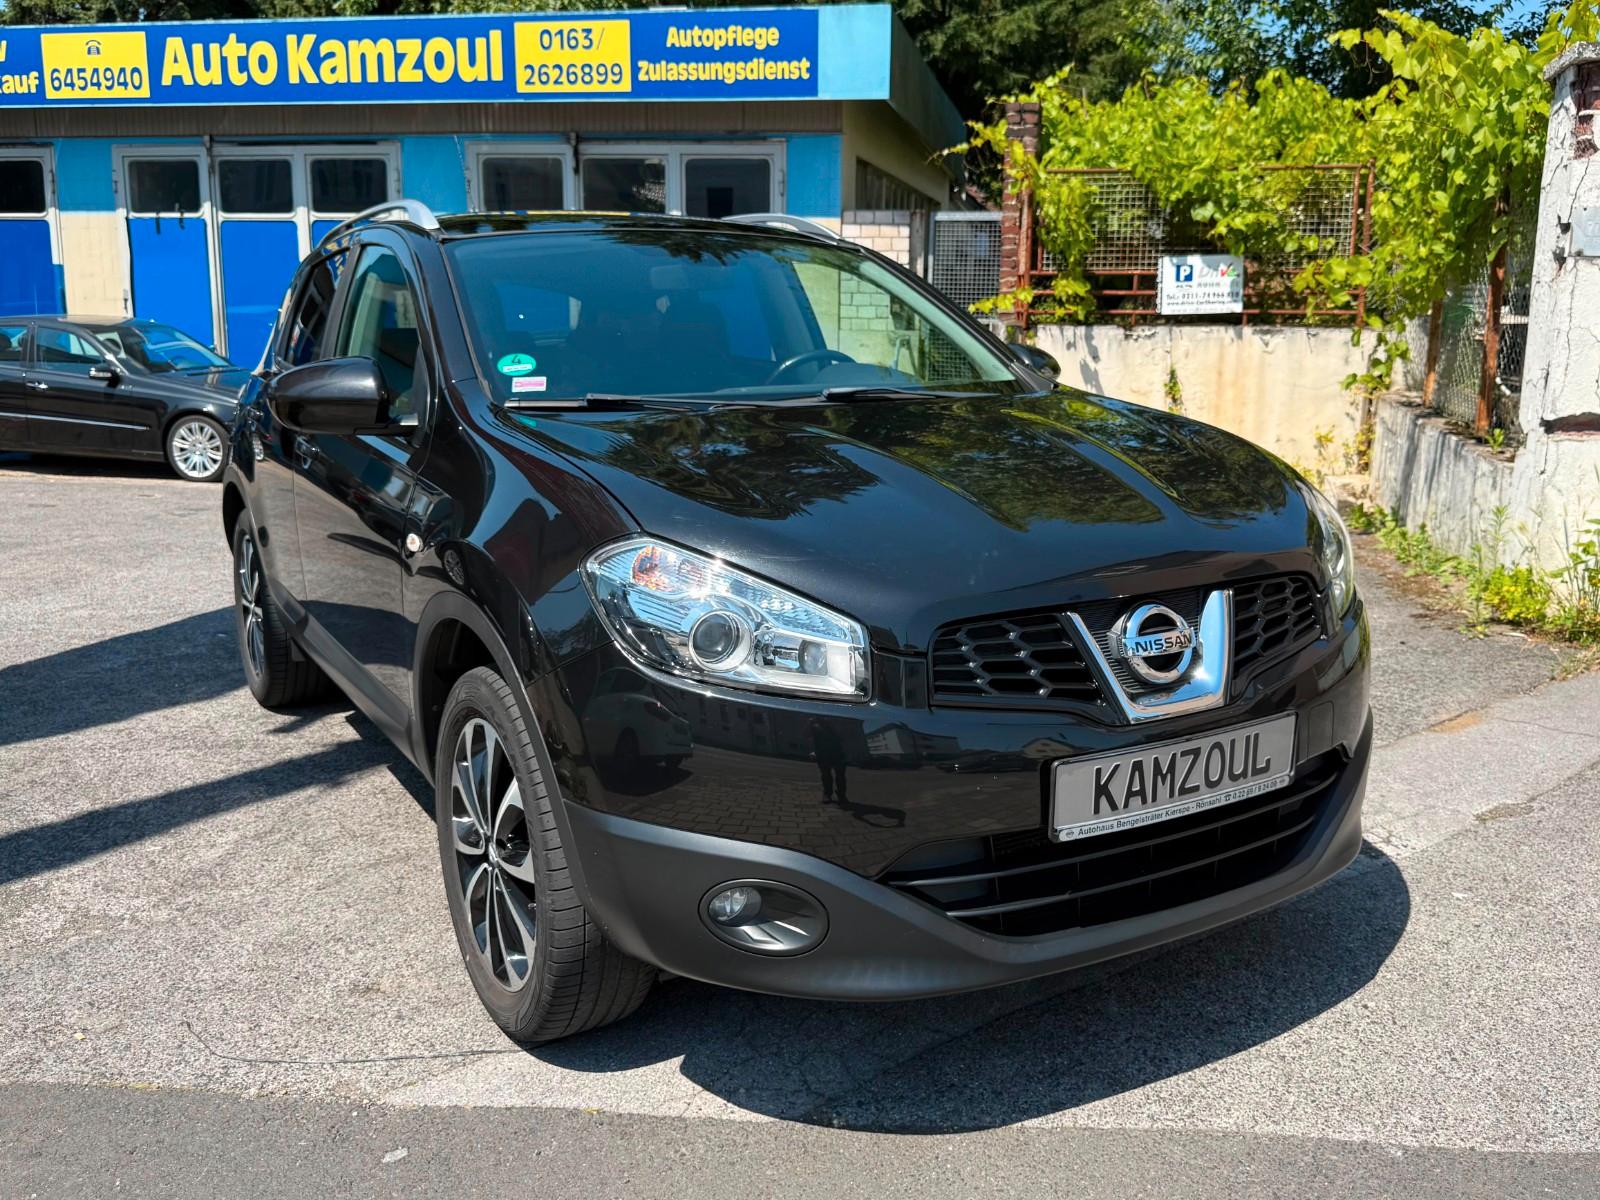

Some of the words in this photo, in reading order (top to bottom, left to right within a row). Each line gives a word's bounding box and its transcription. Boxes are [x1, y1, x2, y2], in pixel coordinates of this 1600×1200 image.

[539, 27, 606, 51] 0163/
[666, 25, 780, 49] Autopflege
[161, 33, 278, 86] Auto
[287, 29, 504, 84] Kamzoul
[0, 70, 39, 94] auf
[50, 66, 142, 92] 6454940
[524, 63, 623, 87] 2626899
[638, 57, 811, 84] Zulassungsdienst
[512, 355, 521, 364] 4
[1135, 629, 1193, 653] NISSAN
[1092, 732, 1271, 815] KAMZOUL
[1078, 822, 1114, 836] Autohaus
[1116, 812, 1163, 828] Bengelsträter
[1165, 805, 1190, 818] Kierspe
